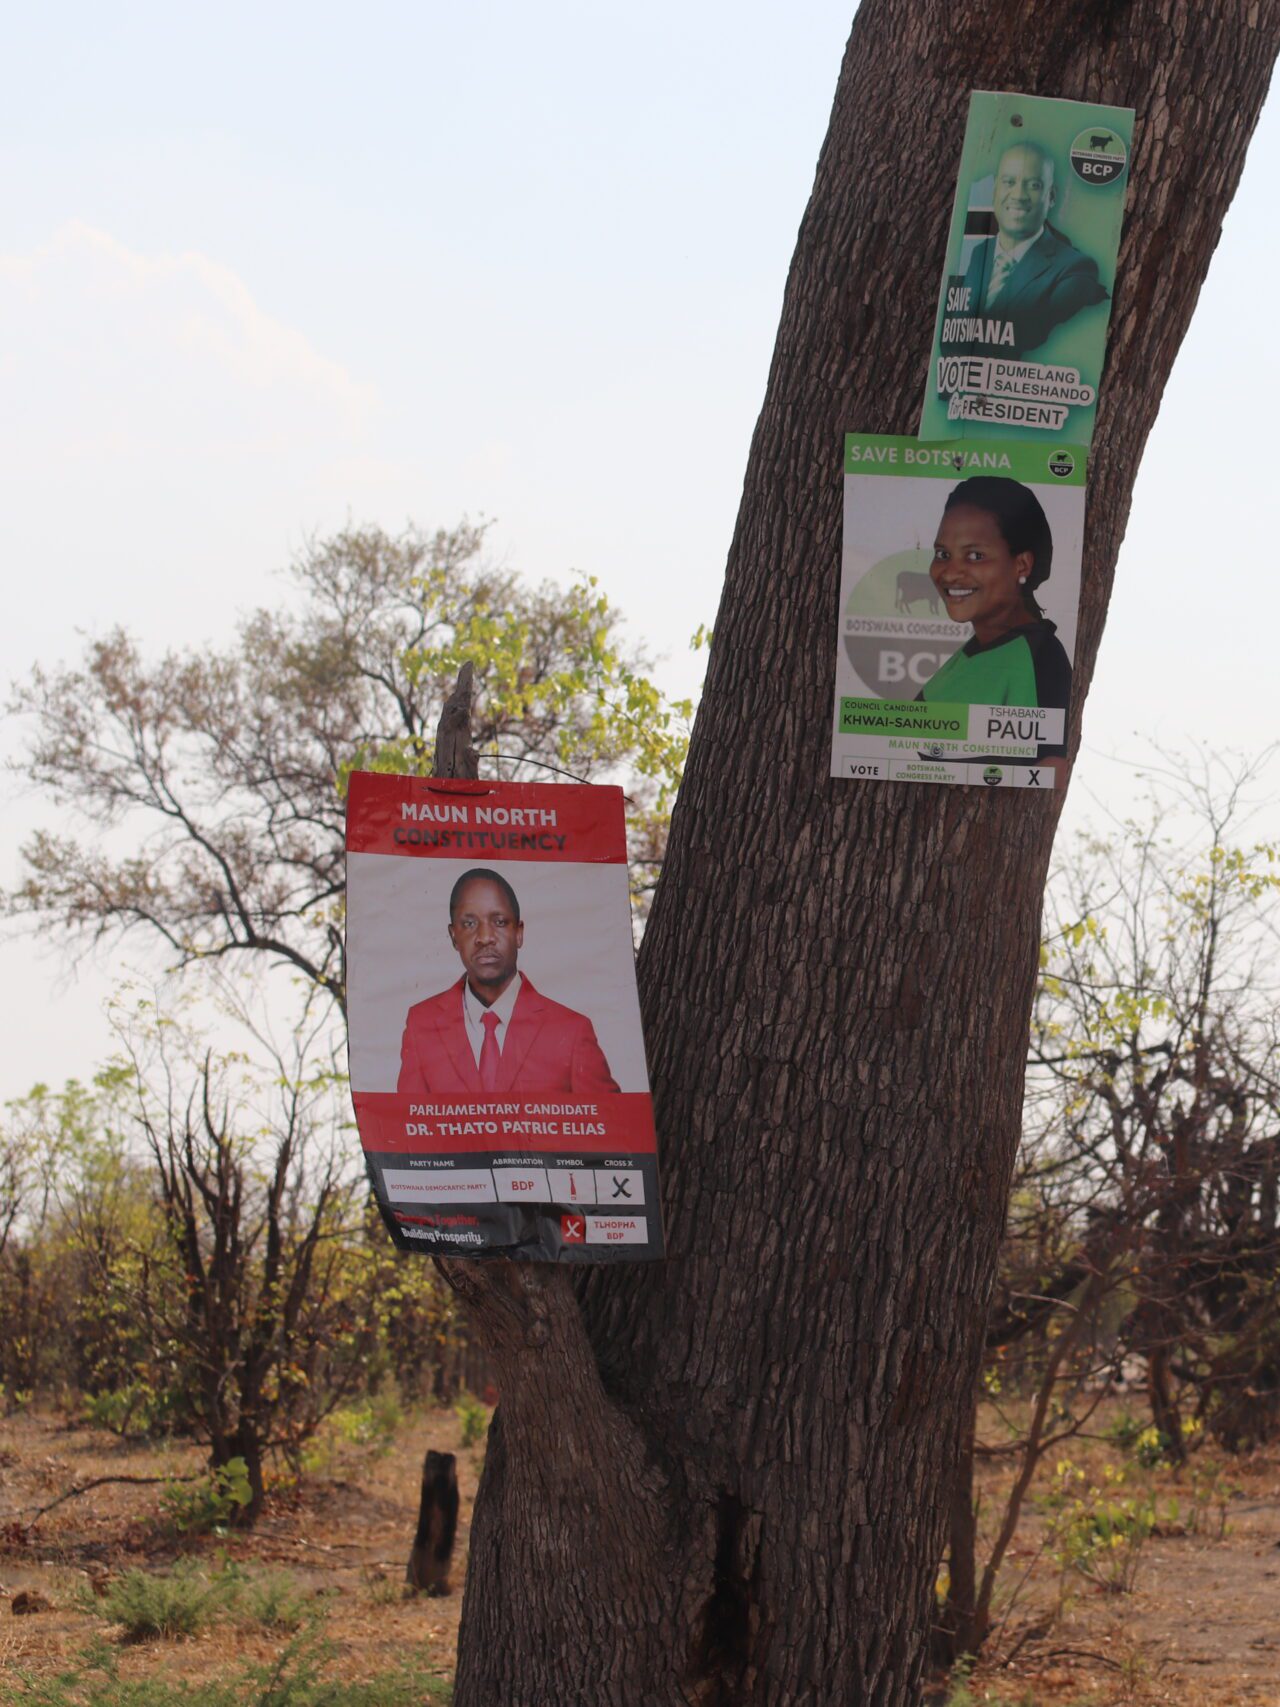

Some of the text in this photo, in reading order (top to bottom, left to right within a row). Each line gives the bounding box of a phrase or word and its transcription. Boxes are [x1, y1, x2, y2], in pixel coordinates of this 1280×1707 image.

[1082, 162, 1113, 177] BCP
[946, 287, 972, 312] SAVE
[942, 318, 1015, 346] BOTSWANA
[938, 361, 983, 388] VOTE
[996, 364, 1075, 384] DUMELANG
[994, 380, 1091, 401] SALESHANDO
[963, 400, 1064, 425] PRESIDENT
[851, 445, 898, 464] SAVE
[846, 620, 904, 633] BOTSWANA
[907, 622, 961, 637] CONGRESS
[845, 701, 928, 713] COUNCIL CANDIDATE
[989, 707, 1046, 719] TSHABANG
[843, 714, 960, 731] KHWAI-SANKUYO
[987, 719, 1047, 741] PAUL
[888, 740, 919, 750] MAUN
[962, 744, 1037, 756] CONSTITUENCY
[850, 765, 879, 776] VOTE
[896, 772, 932, 780] CONGRESS
[907, 764, 946, 773] BOTSWANA
[401, 802, 557, 827] MAUN NORTH
[393, 828, 568, 851] CONSTITUENCY
[409, 1103, 599, 1116] PARLIAMENTARY CANDIDATE
[406, 1121, 606, 1136] DR. THATO PATRIC ELIAS
[511, 1181, 535, 1191] BDP
[594, 1221, 636, 1229] TLHOPHA
[401, 1227, 484, 1245] Building Prosperity.
[607, 1232, 624, 1240] BDP
